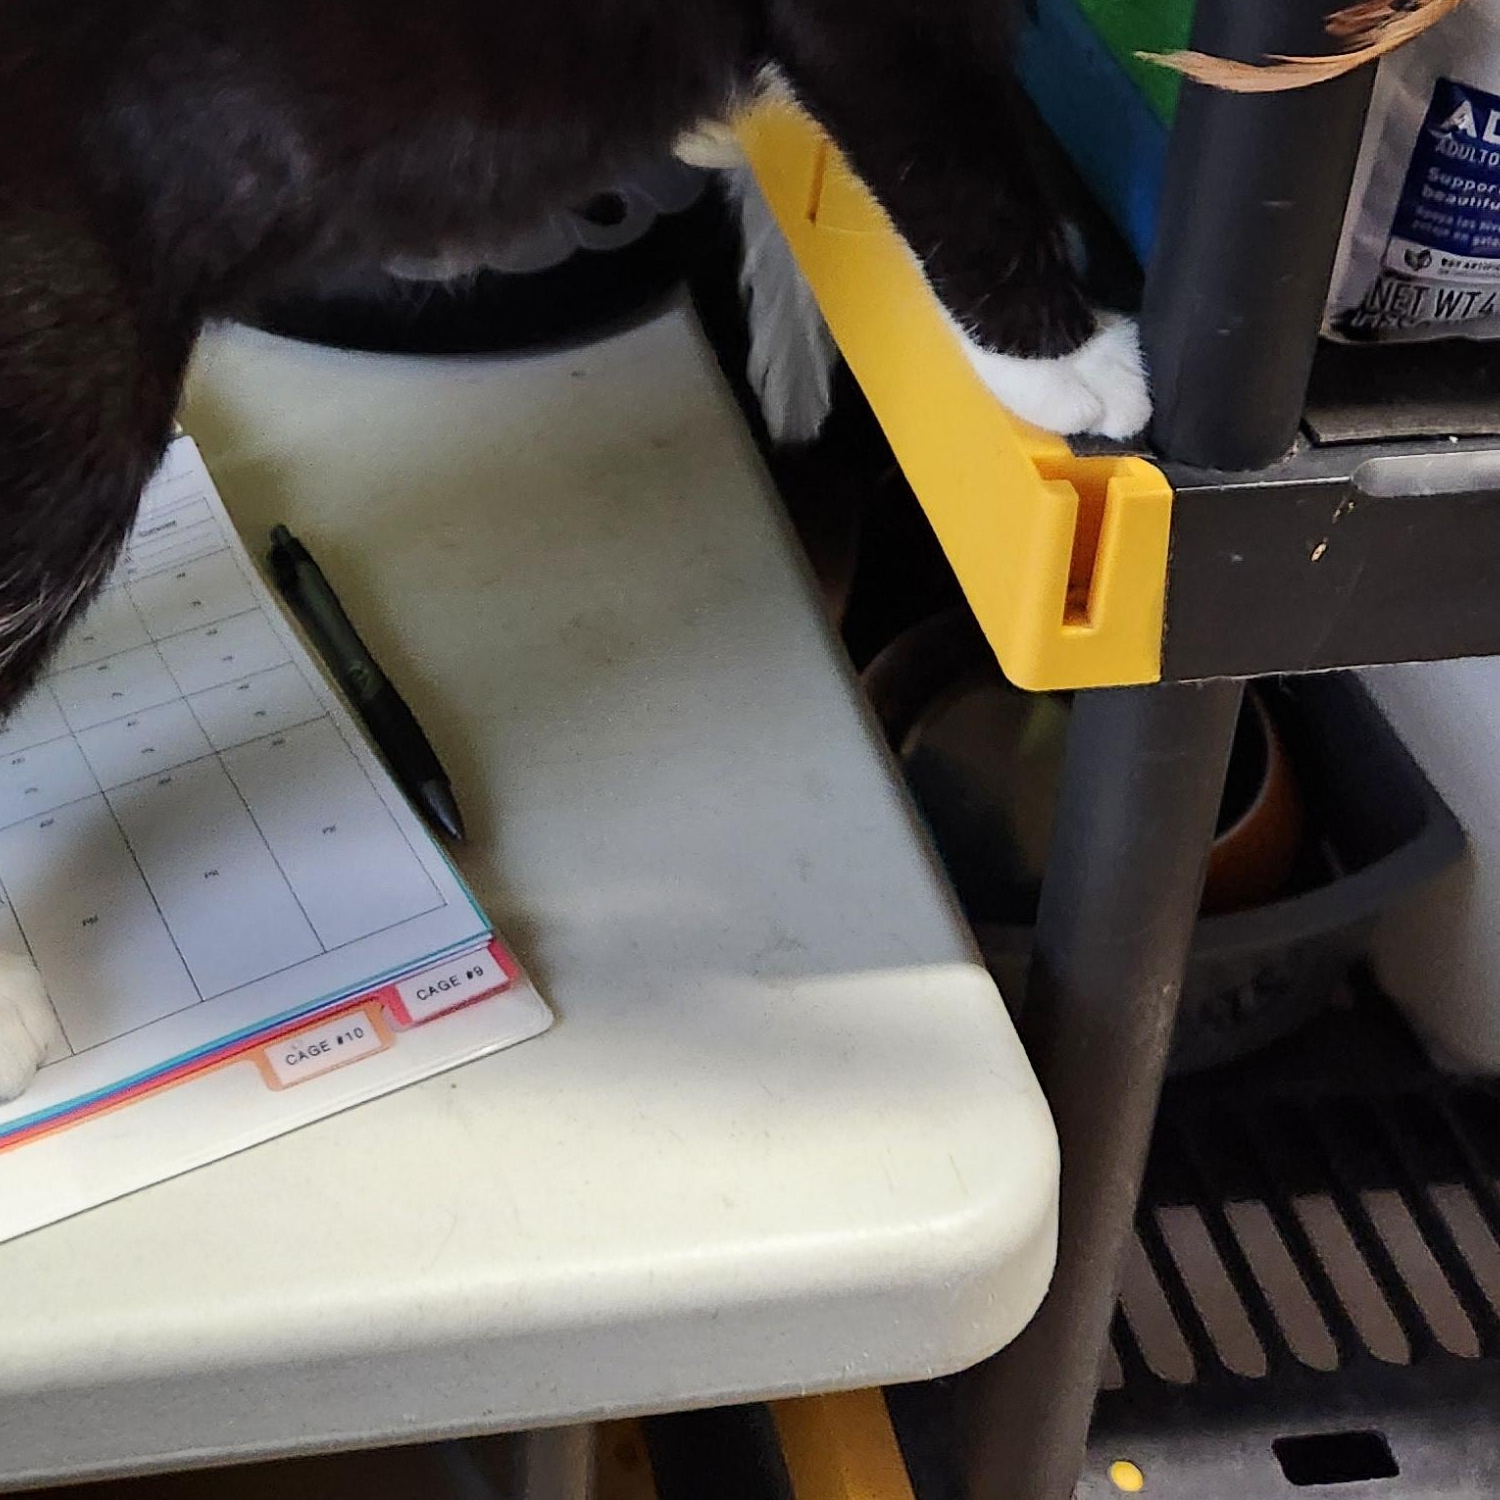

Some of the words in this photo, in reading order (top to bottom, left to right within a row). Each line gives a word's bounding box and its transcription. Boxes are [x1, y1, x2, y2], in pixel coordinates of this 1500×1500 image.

[1426, 166, 1500, 195] Suppor
[1367, 278, 1430, 317] NET
[1434, 287, 1482, 320] WT
[414, 974, 461, 1001] CAGE
[466, 965, 485, 981] #9
[284, 1039, 331, 1067] CAGE
[336, 1025, 365, 1046] #10
